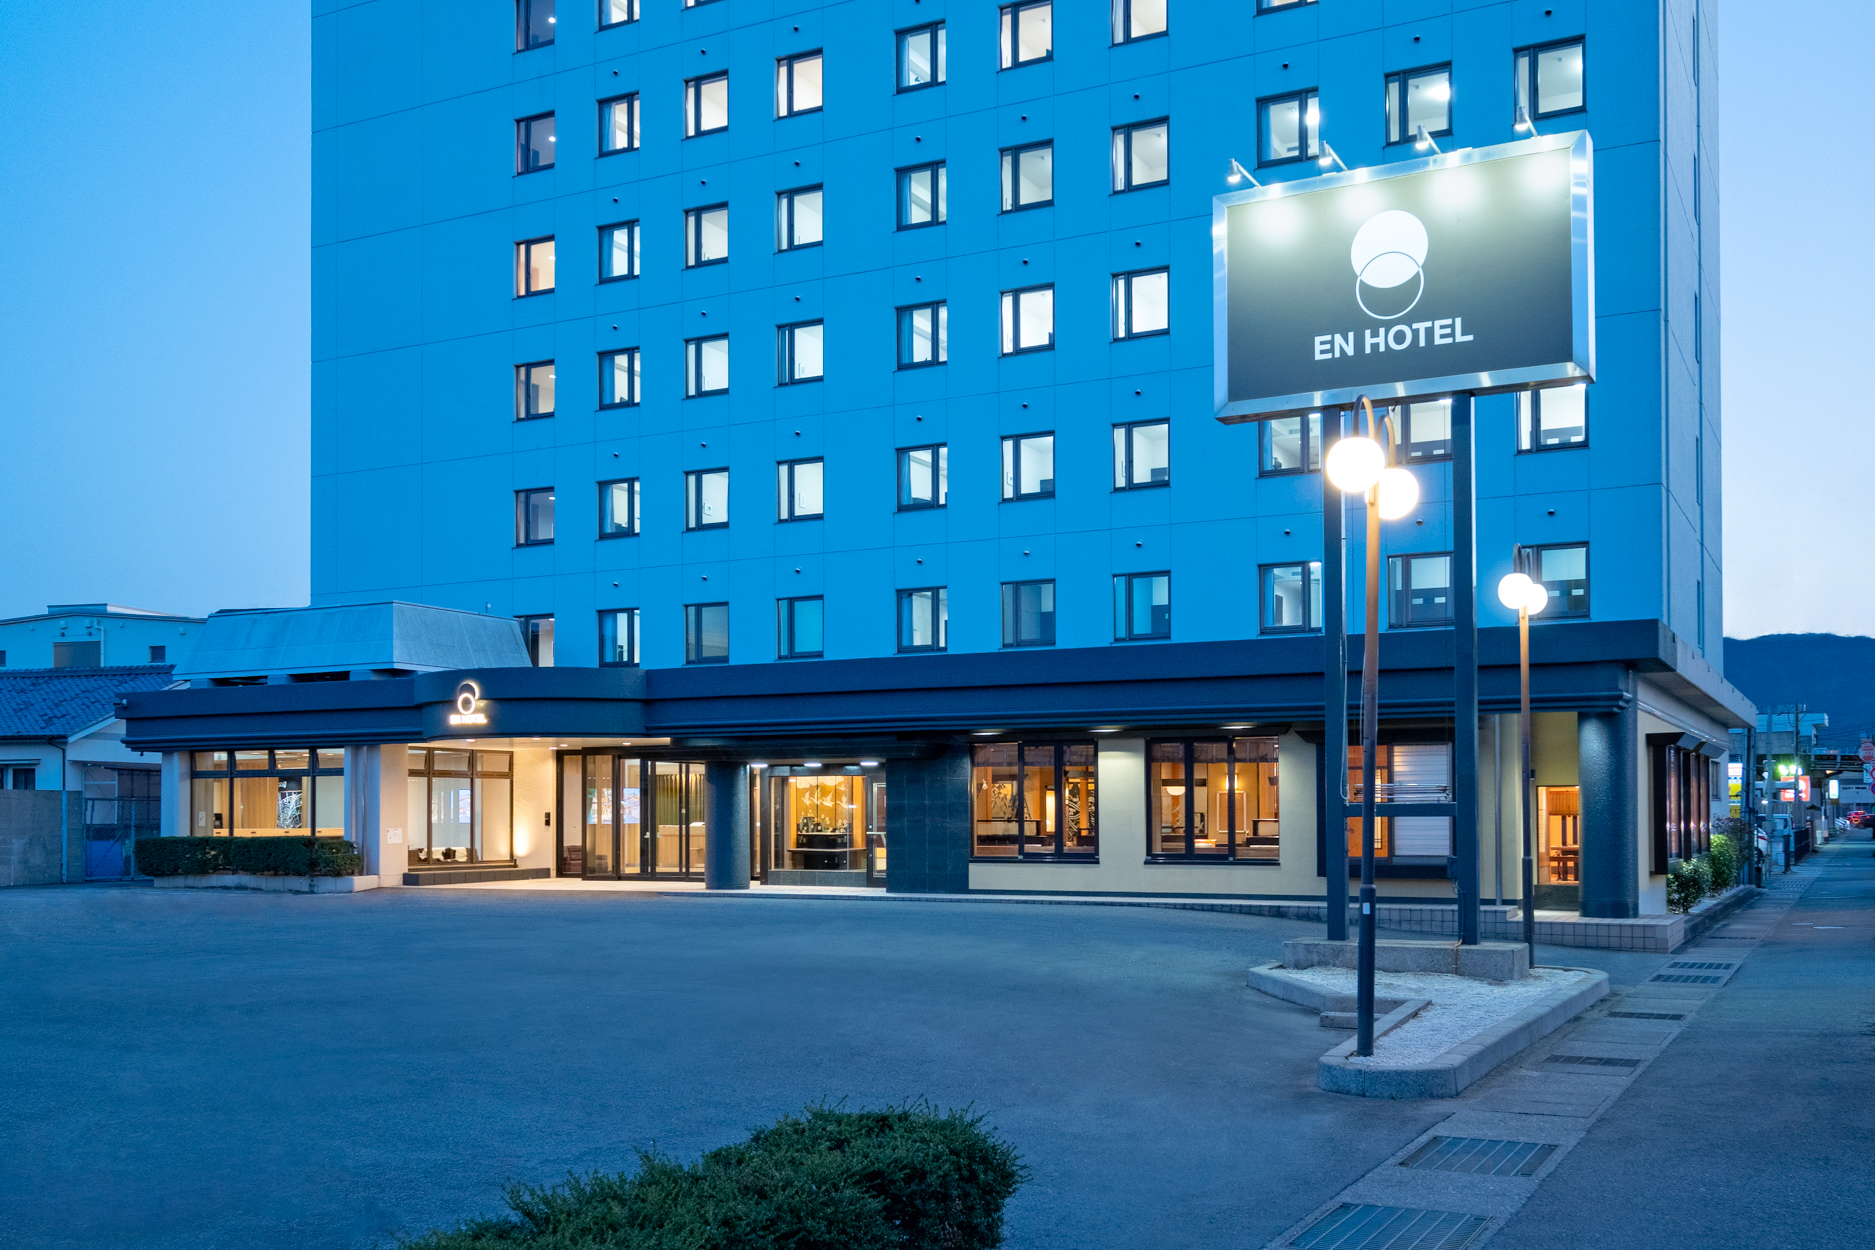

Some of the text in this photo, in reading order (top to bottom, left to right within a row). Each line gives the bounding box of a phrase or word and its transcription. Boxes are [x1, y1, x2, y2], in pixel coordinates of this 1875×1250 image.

[1314, 317, 1474, 361] EN HOTEL
[462, 713, 487, 724] HOTEL
